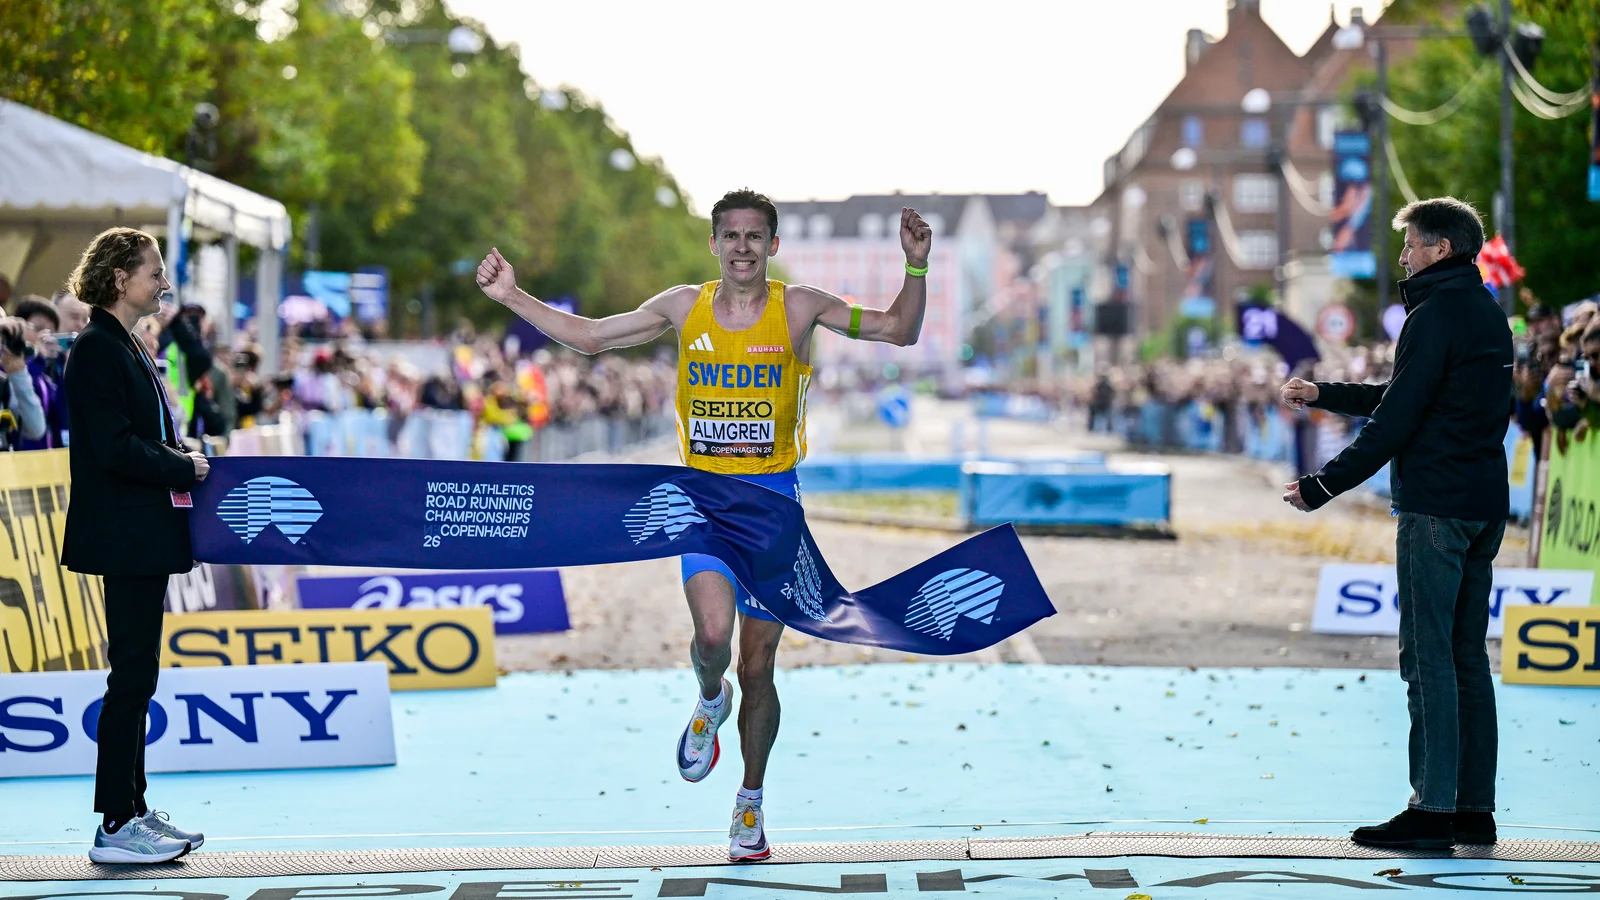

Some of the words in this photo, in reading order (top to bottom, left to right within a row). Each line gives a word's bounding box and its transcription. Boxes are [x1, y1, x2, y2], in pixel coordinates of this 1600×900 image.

[688, 361, 782, 388] SWEDEN
[691, 400, 773, 418] SEIKO
[693, 421, 770, 440] ALMGREN
[710, 446, 762, 454] COPENHAGEN
[427, 482, 470, 494] WORLD
[472, 483, 535, 496] ATHLETICS
[426, 495, 467, 509] ROAD
[470, 496, 533, 511] RUNNING
[425, 510, 531, 524] CHAMPIONSHIPS
[440, 524, 528, 538] COPENHAGEN
[423, 535, 441, 547] 26
[168, 622, 479, 674] SEIKO
[1517, 618, 1600, 674] S
